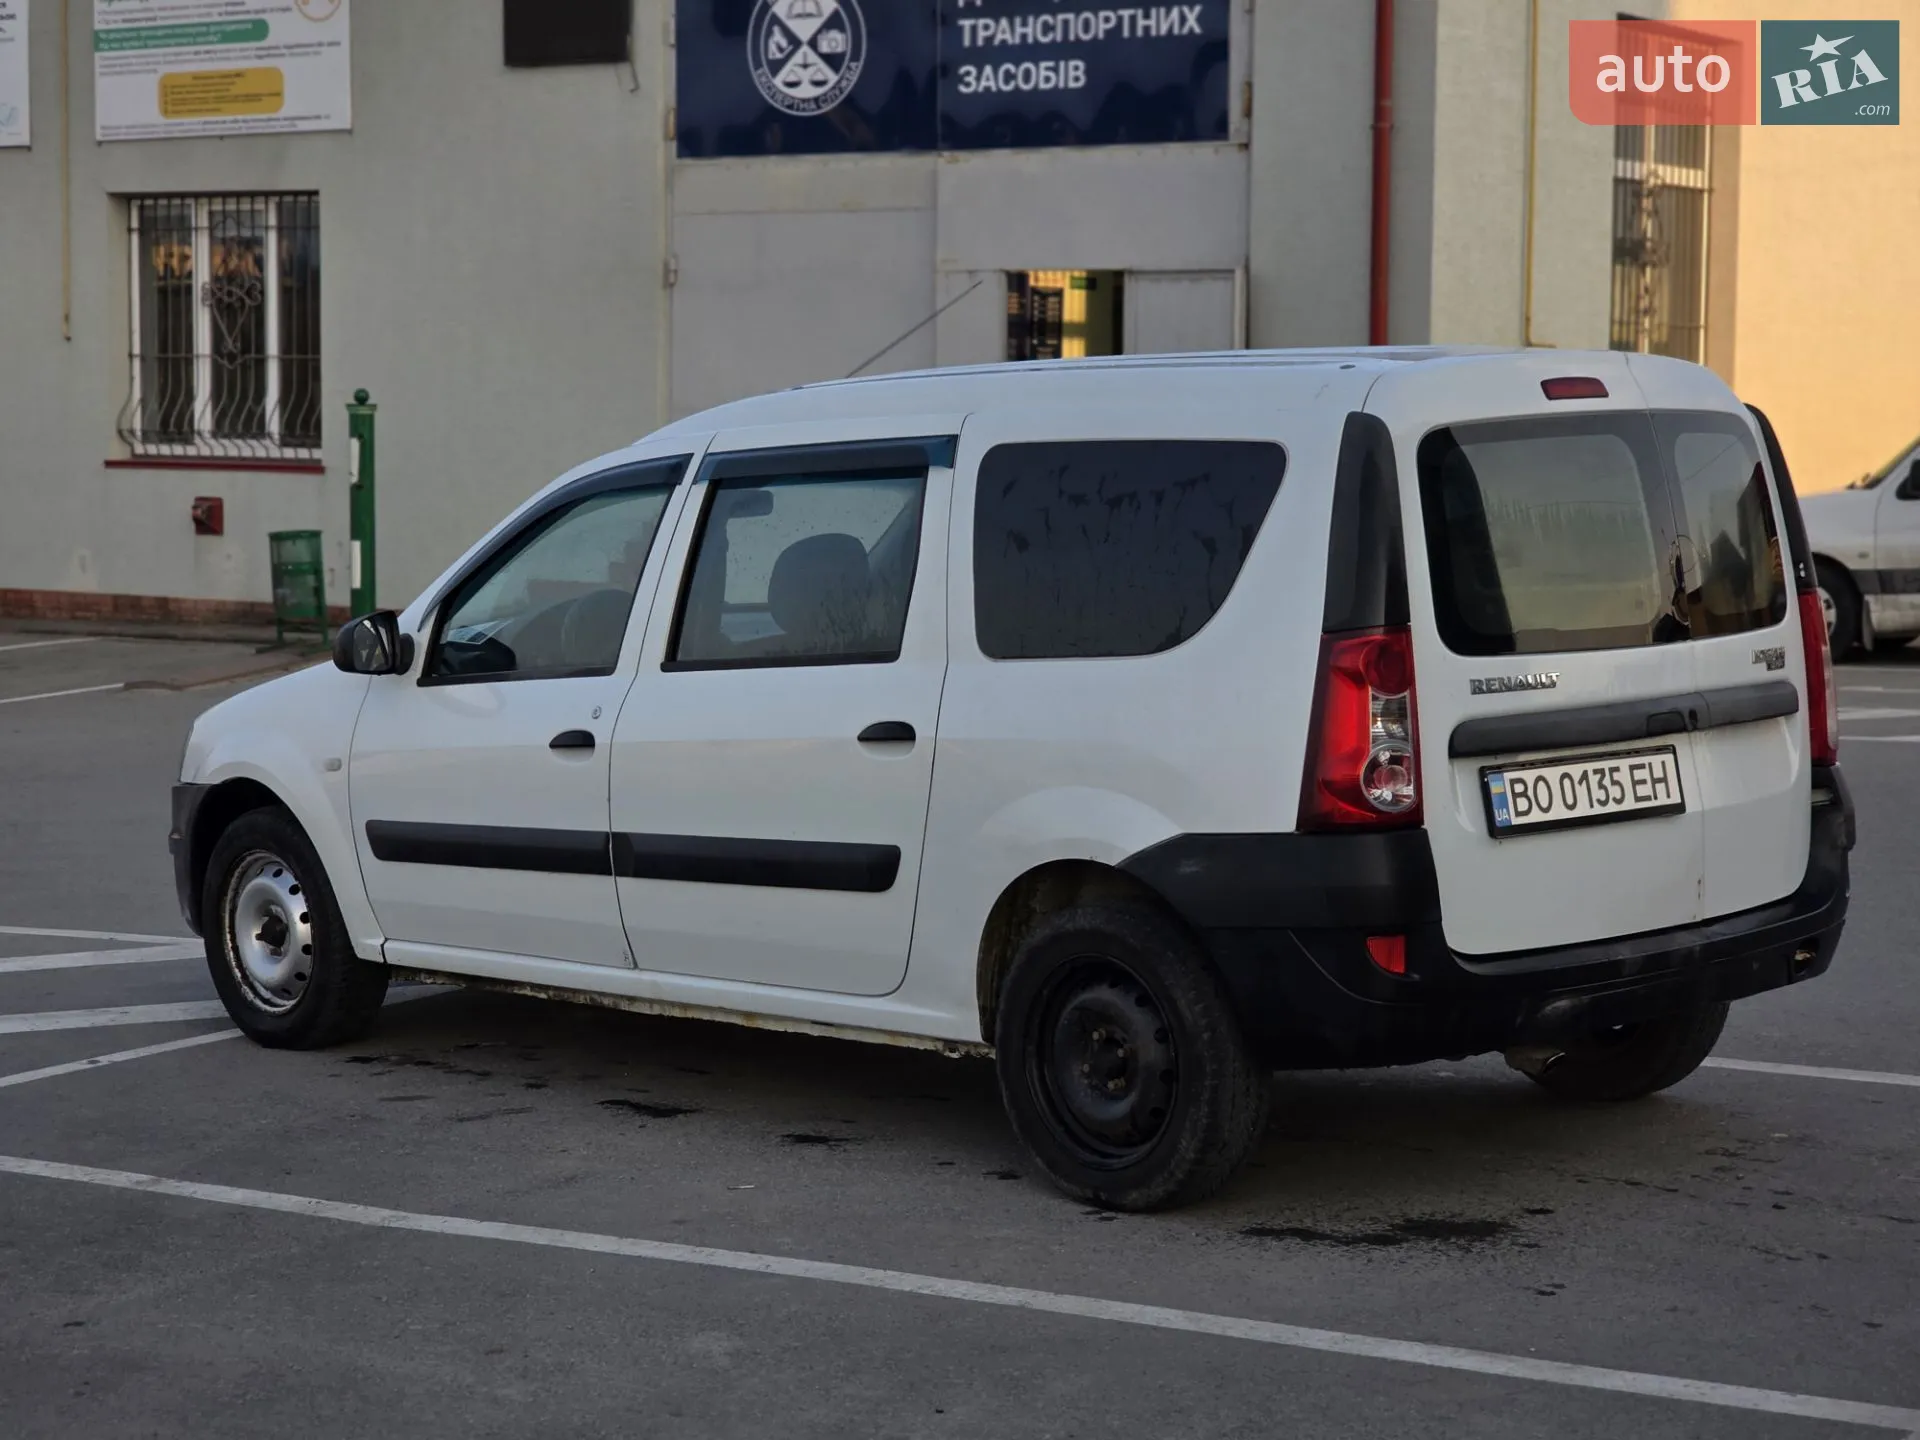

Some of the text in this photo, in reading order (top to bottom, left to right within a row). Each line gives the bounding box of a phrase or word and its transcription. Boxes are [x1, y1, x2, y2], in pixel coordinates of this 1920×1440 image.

[957, 5, 1203, 48] ТРАНСПОРТНИХ
[957, 59, 1087, 93] ЗАСОБІВ
[1469, 672, 1560, 695] RENAULT
[1509, 760, 1671, 818] BO 0135 EH
[1494, 807, 1510, 822] UA
